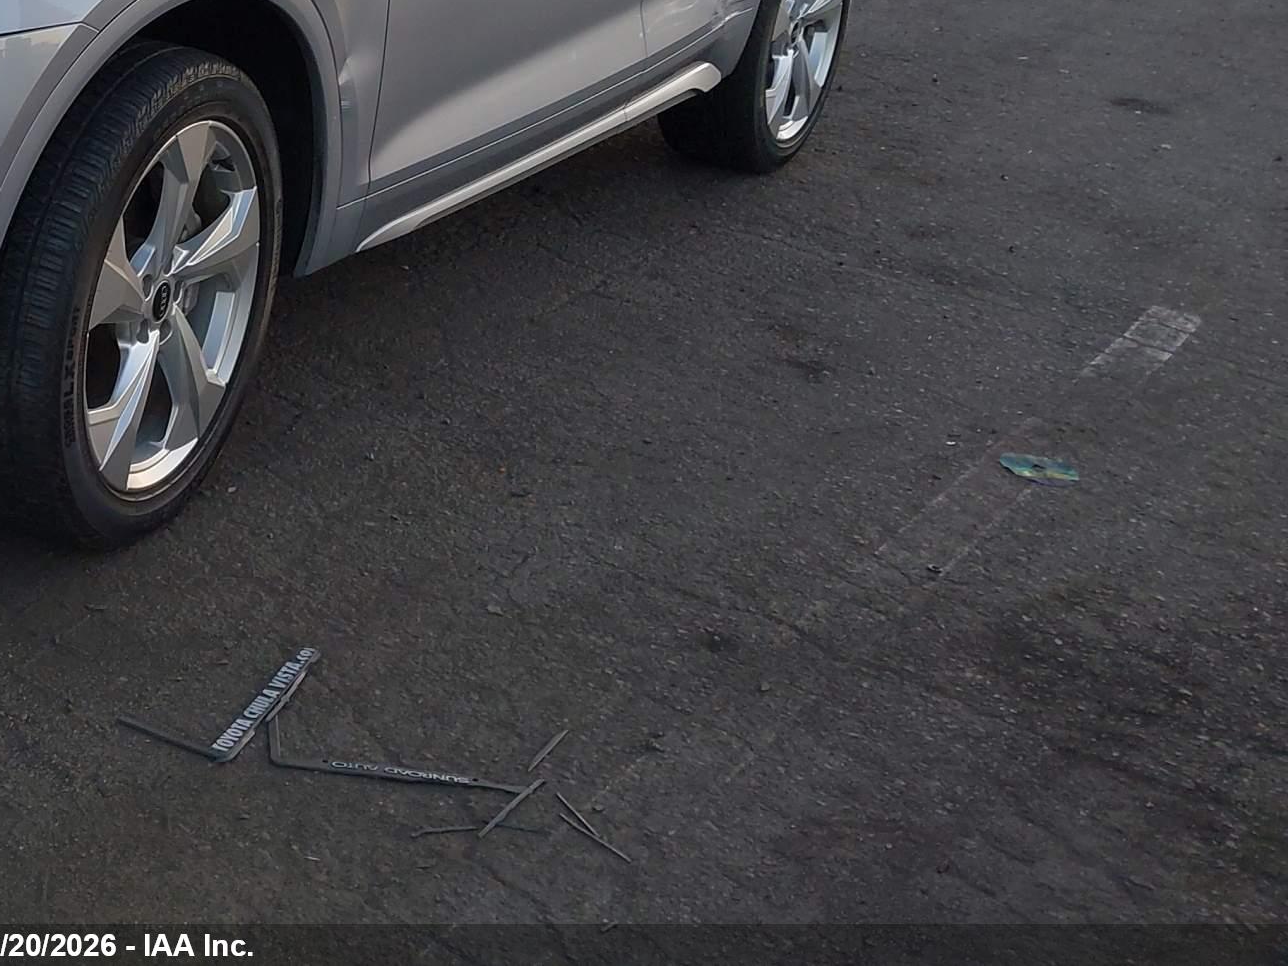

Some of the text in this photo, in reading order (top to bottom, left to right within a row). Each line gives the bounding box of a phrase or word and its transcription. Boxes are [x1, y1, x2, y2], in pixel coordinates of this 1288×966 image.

[212, 718, 254, 752] TOYOTA
[243, 689, 280, 719] CHULA
[331, 761, 470, 784] SUNROAD AUTO
